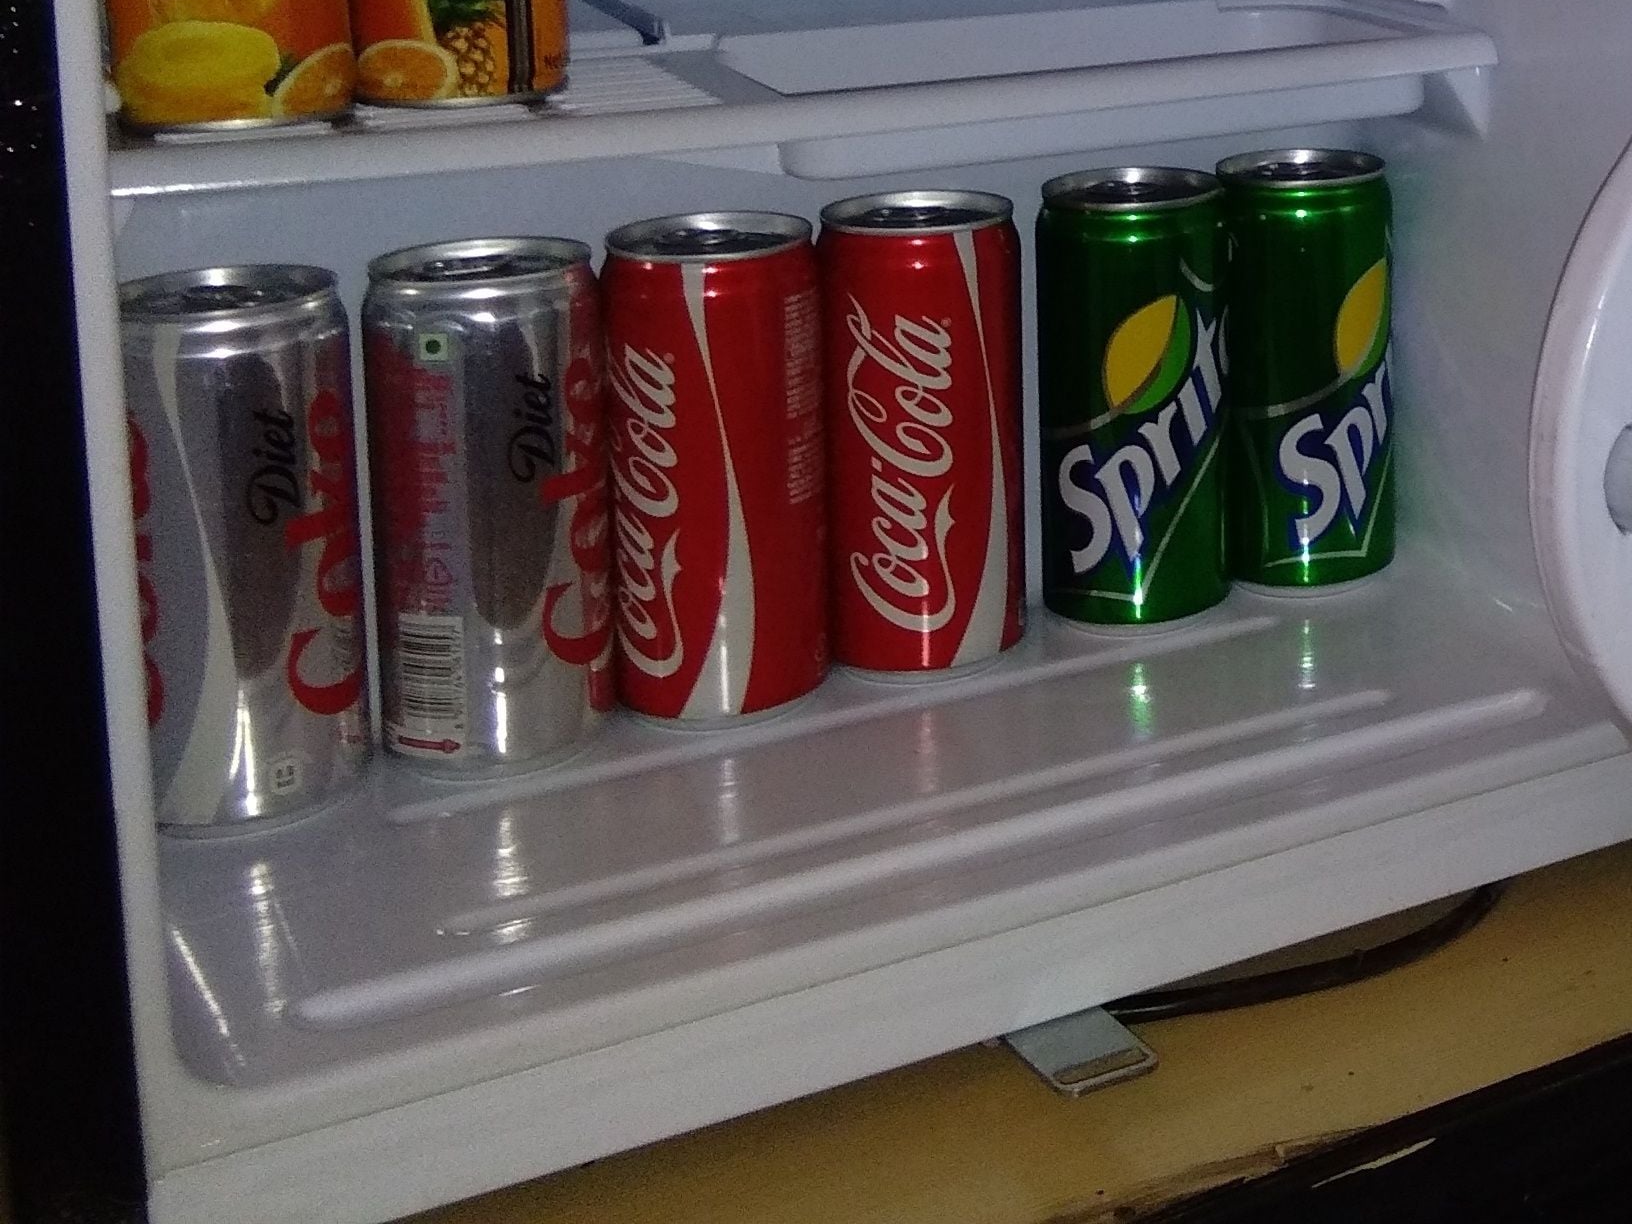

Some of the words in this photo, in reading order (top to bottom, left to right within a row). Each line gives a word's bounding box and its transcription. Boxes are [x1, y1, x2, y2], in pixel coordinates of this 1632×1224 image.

[245, 408, 301, 525] Diet
[508, 373, 556, 483] Diet
[1279, 344, 1392, 546] Spr
